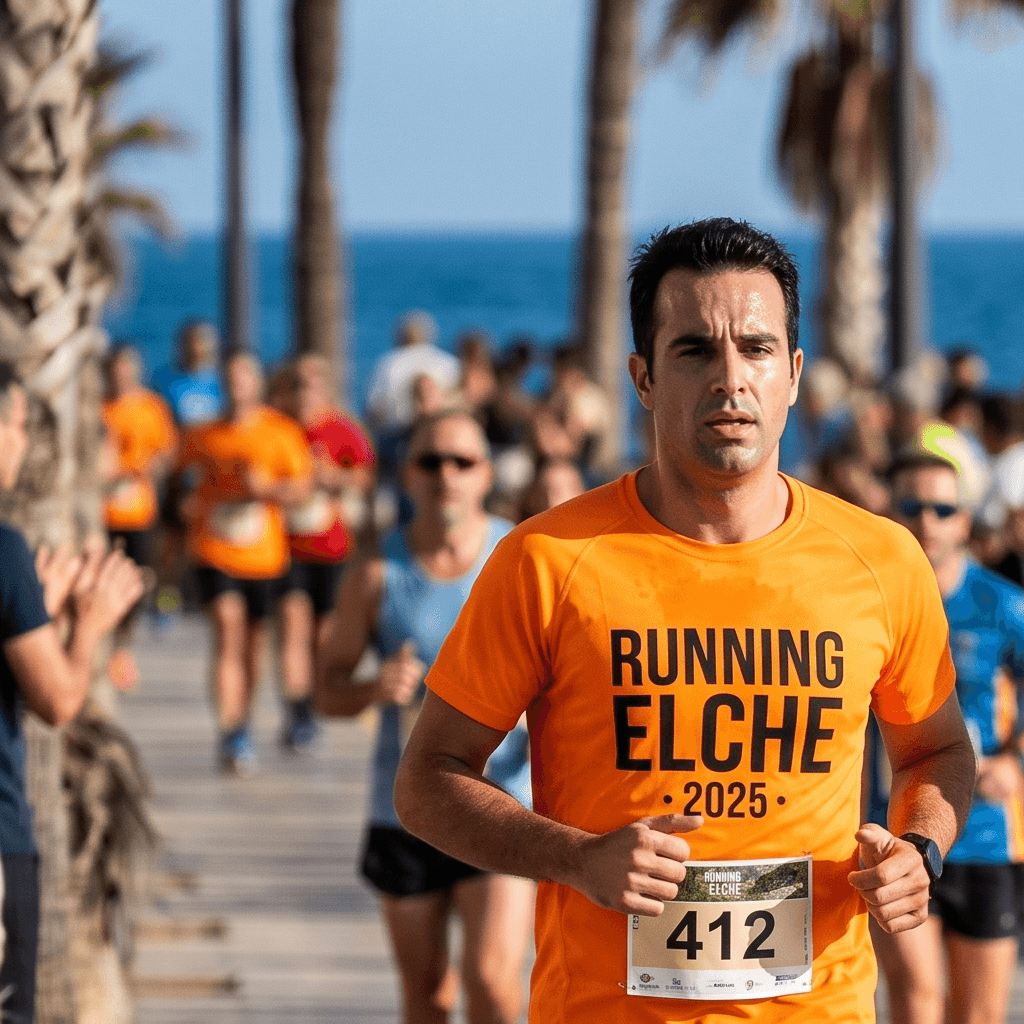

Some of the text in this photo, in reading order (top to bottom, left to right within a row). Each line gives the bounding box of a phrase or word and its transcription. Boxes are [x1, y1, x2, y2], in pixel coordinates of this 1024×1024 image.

[611, 628, 844, 689] RUNNING
[613, 693, 843, 774] ELCHE
[683, 781, 767, 819] 2025
[666, 910, 775, 960] 412
